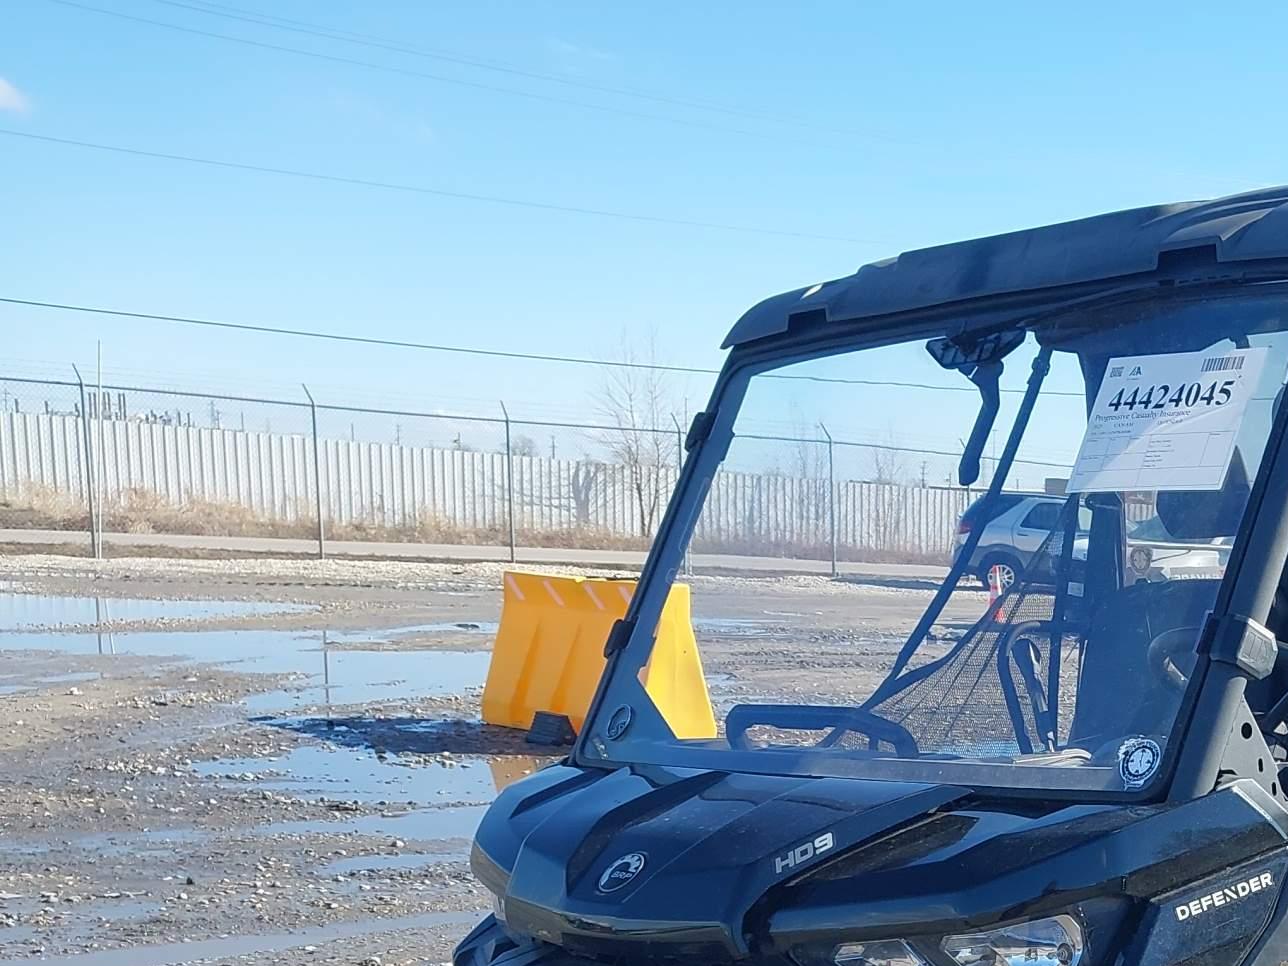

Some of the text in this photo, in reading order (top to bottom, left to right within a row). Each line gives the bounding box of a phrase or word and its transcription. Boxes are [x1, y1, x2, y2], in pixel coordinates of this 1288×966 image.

[1108, 380, 1236, 412] 44424045
[1131, 410, 1157, 420] Casualty
[1160, 409, 1191, 418] Insurance
[775, 832, 834, 874] HD9
[610, 870, 633, 880] BRP
[1175, 872, 1273, 921] DEFENDER
